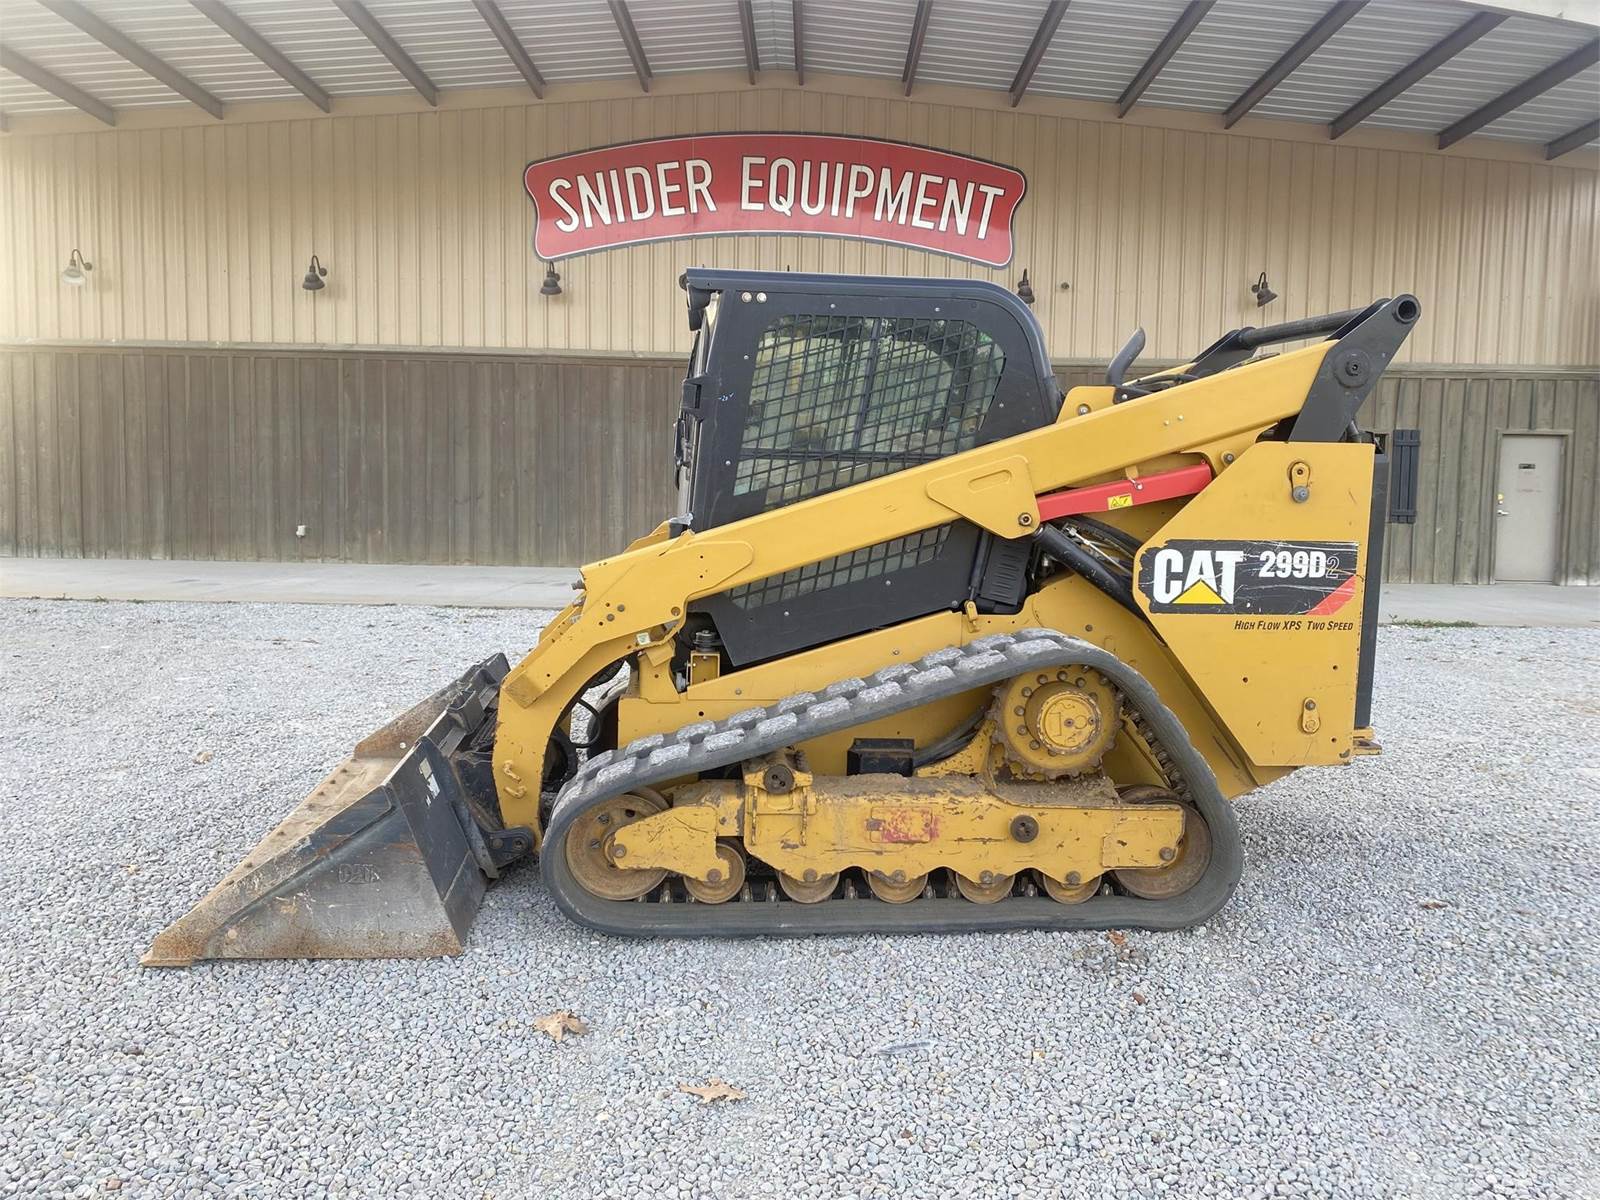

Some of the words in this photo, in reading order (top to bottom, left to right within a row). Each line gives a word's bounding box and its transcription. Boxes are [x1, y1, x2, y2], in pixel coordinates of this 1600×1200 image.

[548, 159, 716, 233] SNIDER
[741, 155, 1005, 240] EQUIPMENT
[1152, 549, 1243, 605] CAT
[1259, 551, 1339, 579] 299D2
[1234, 620, 1255, 630] HIGH
[1257, 620, 1281, 630] FLOW
[1282, 620, 1302, 630] XPS
[1307, 620, 1325, 630] TWO
[1326, 620, 1354, 630] SPEED
